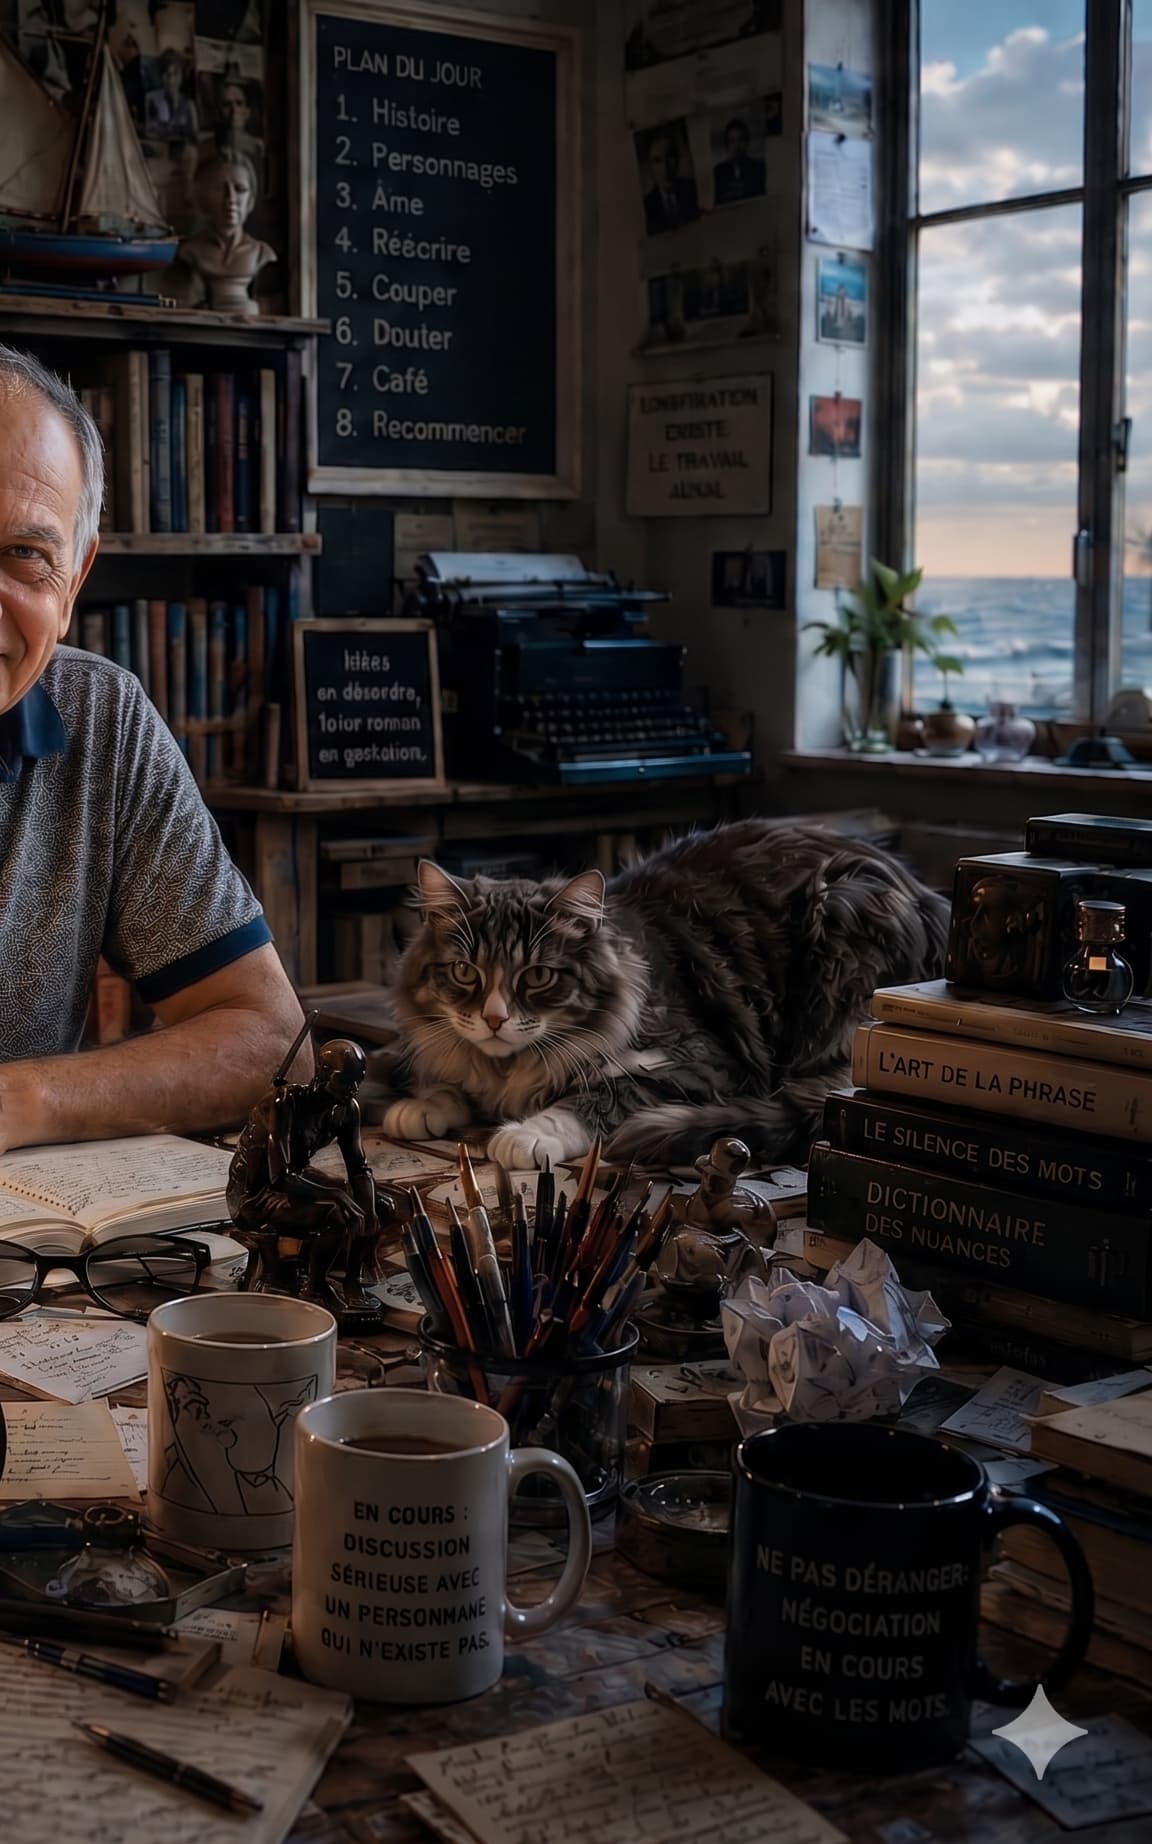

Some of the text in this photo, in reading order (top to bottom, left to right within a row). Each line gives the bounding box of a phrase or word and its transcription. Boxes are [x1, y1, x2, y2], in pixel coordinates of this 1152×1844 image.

[333, 46, 482, 88] PLAN DU JOUR
[336, 93, 461, 135] 1. Histoire
[335, 136, 519, 188] 2. Personnages
[336, 181, 358, 211] 3.
[335, 226, 358, 254] 4.
[336, 270, 458, 312] 5. Couper
[336, 316, 453, 350] 6. Douter
[336, 362, 429, 395] 7. Café
[336, 408, 528, 445] 8. Recommencer
[879, 1052, 1097, 1113] L'ART DE LA PHRASE
[863, 1117, 1104, 1192] LE SILENCE DES MOTS
[866, 1180, 1047, 1248] DICTIONNAIRE
[864, 1212, 1011, 1269] DES NUANCES
[354, 1502, 378, 1522] EN
[388, 1505, 455, 1525] COURS
[344, 1533, 469, 1559] DISCUSSION
[331, 1563, 480, 1593] SÉRIEUSE AVEC
[756, 1544, 785, 1576] NE
[791, 1556, 837, 1588] PAS
[325, 1595, 350, 1619] UN
[782, 1597, 941, 1638] NÉGOCIATION
[321, 1627, 350, 1654] QUI
[360, 1639, 450, 1661] N'EXISTE
[800, 1645, 924, 1681] EN COURS
[765, 1680, 823, 1716] AVEC
[833, 1697, 879, 1723] LES
